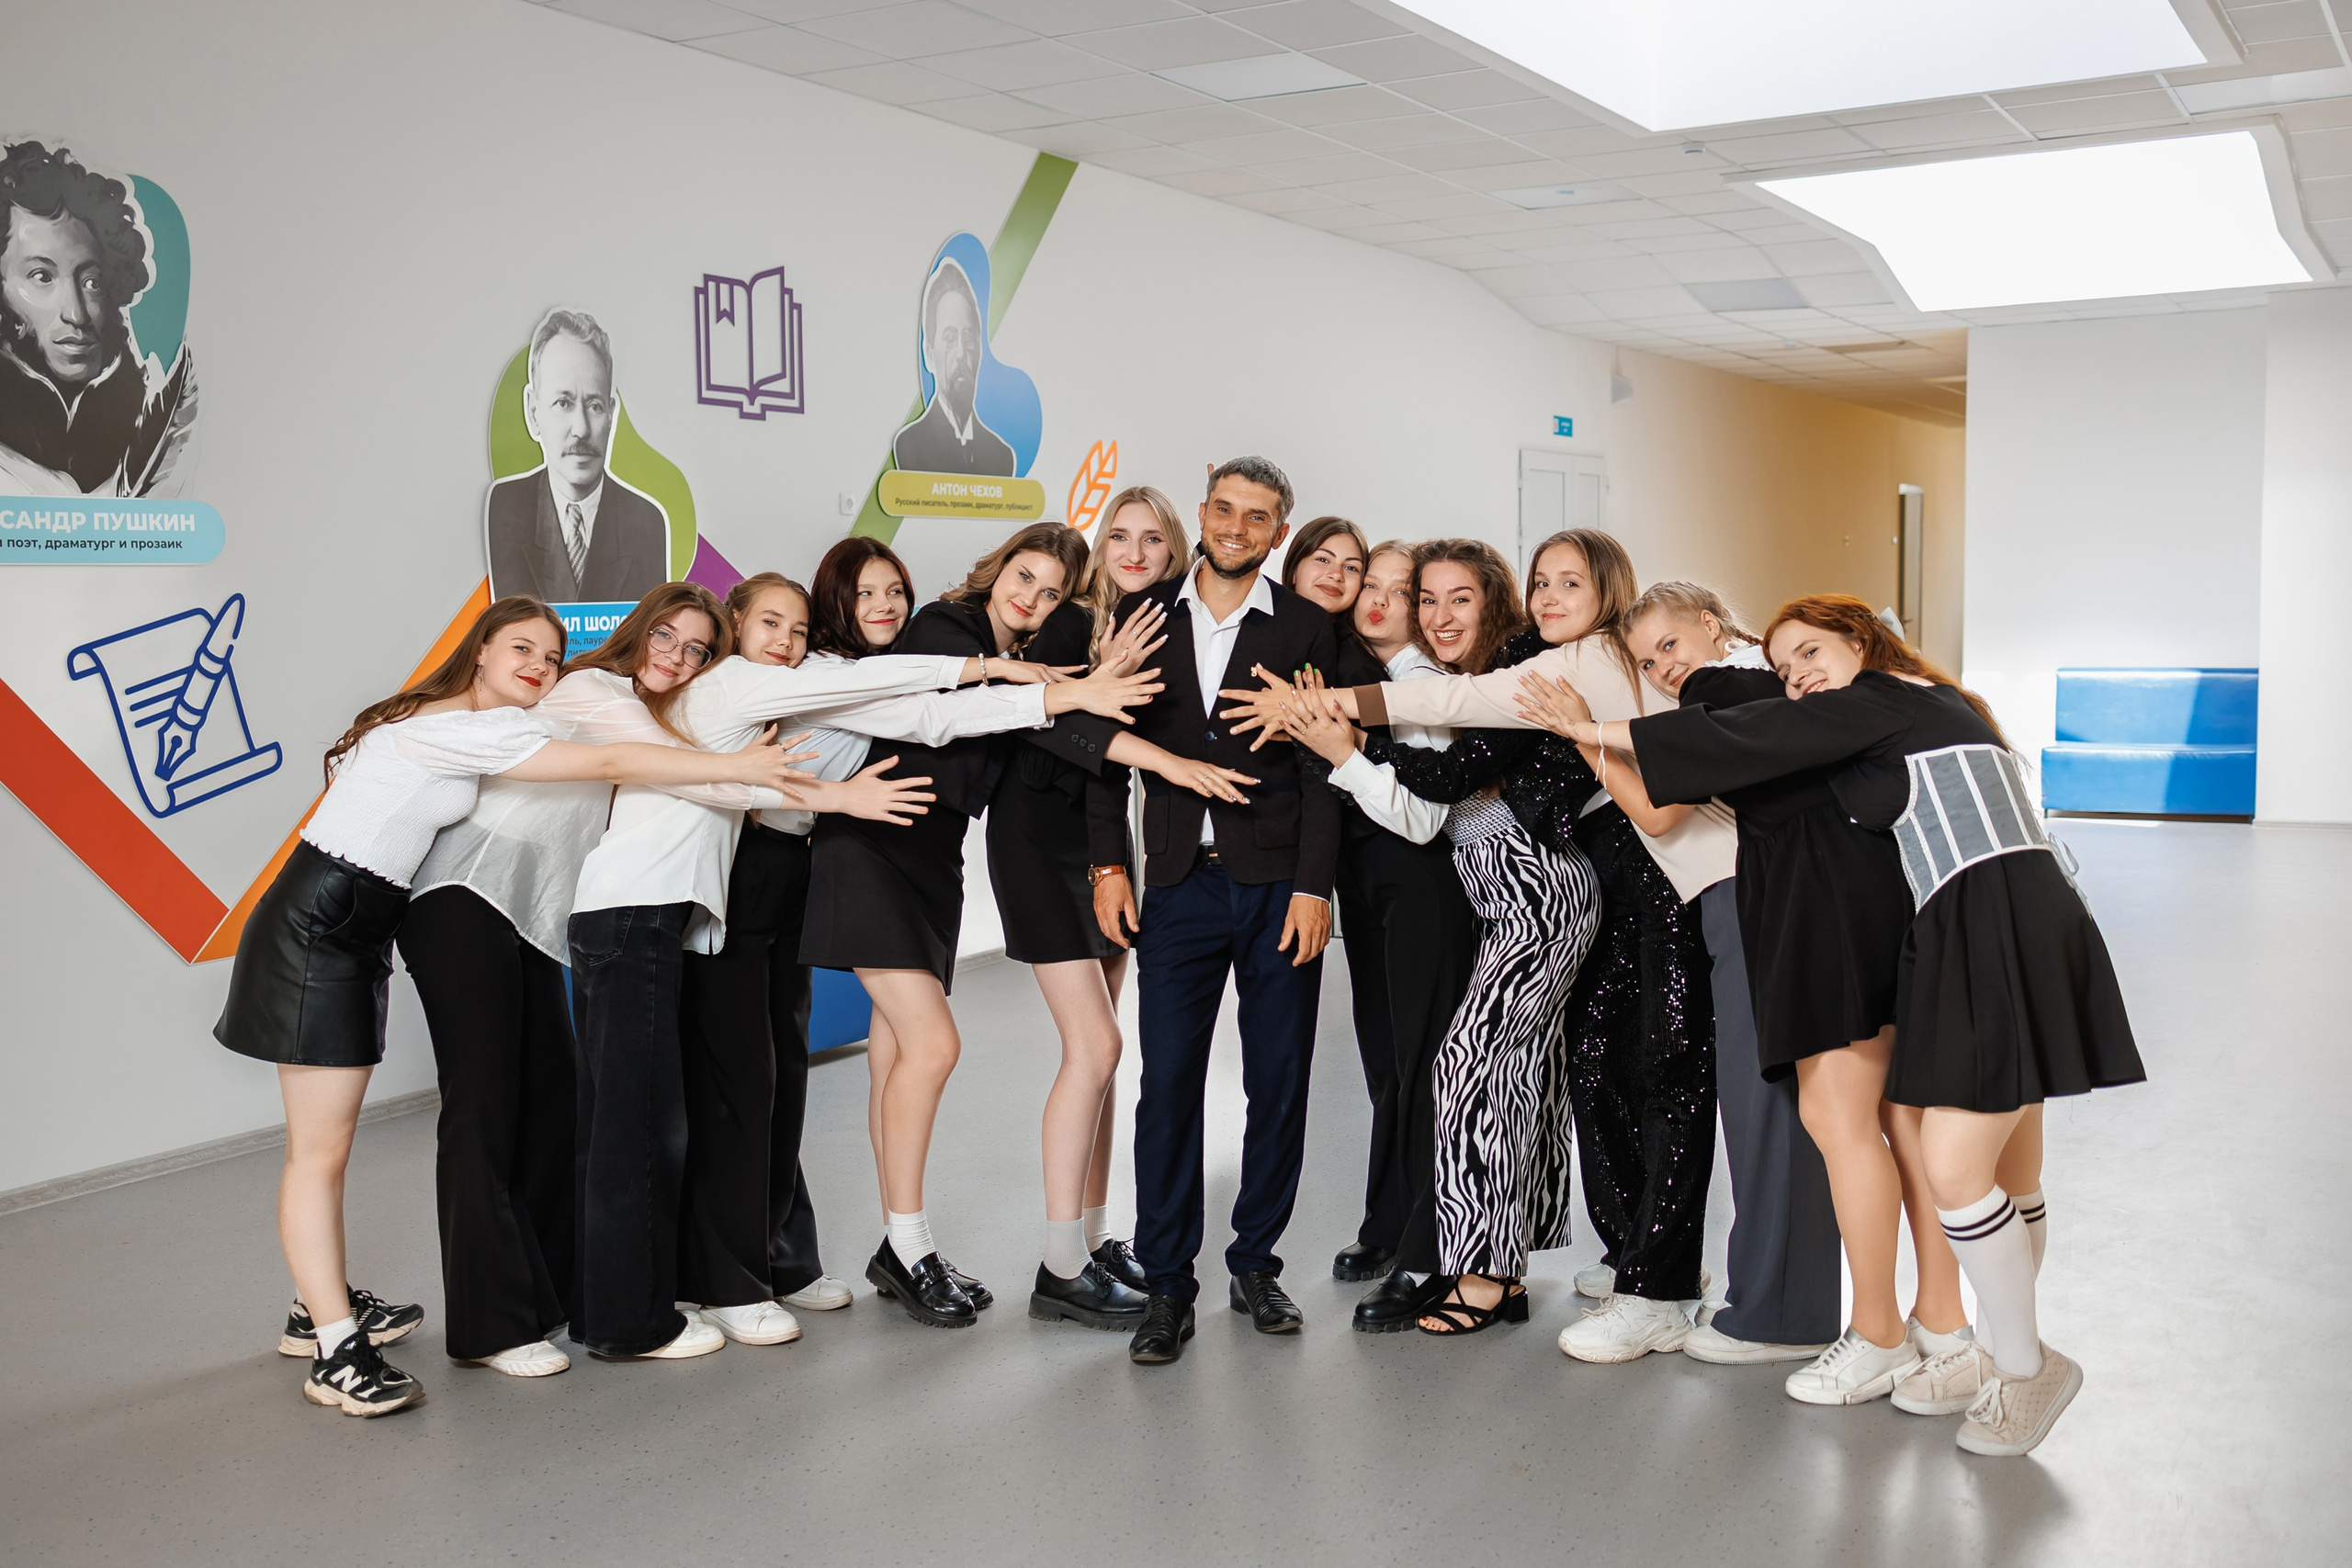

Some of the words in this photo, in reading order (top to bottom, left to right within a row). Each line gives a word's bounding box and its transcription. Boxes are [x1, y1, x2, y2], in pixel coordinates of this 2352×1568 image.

[931, 482, 967, 496] АНТОН
[969, 484, 1003, 498] ЧЕХОВ
[895, 497, 920, 507] Русский
[94, 513, 196, 532] ПУШКИН
[6, 538, 41, 550] поэт,
[44, 539, 116, 551] драматург
[119, 540, 128, 548] и
[130, 540, 183, 551] прозаик
